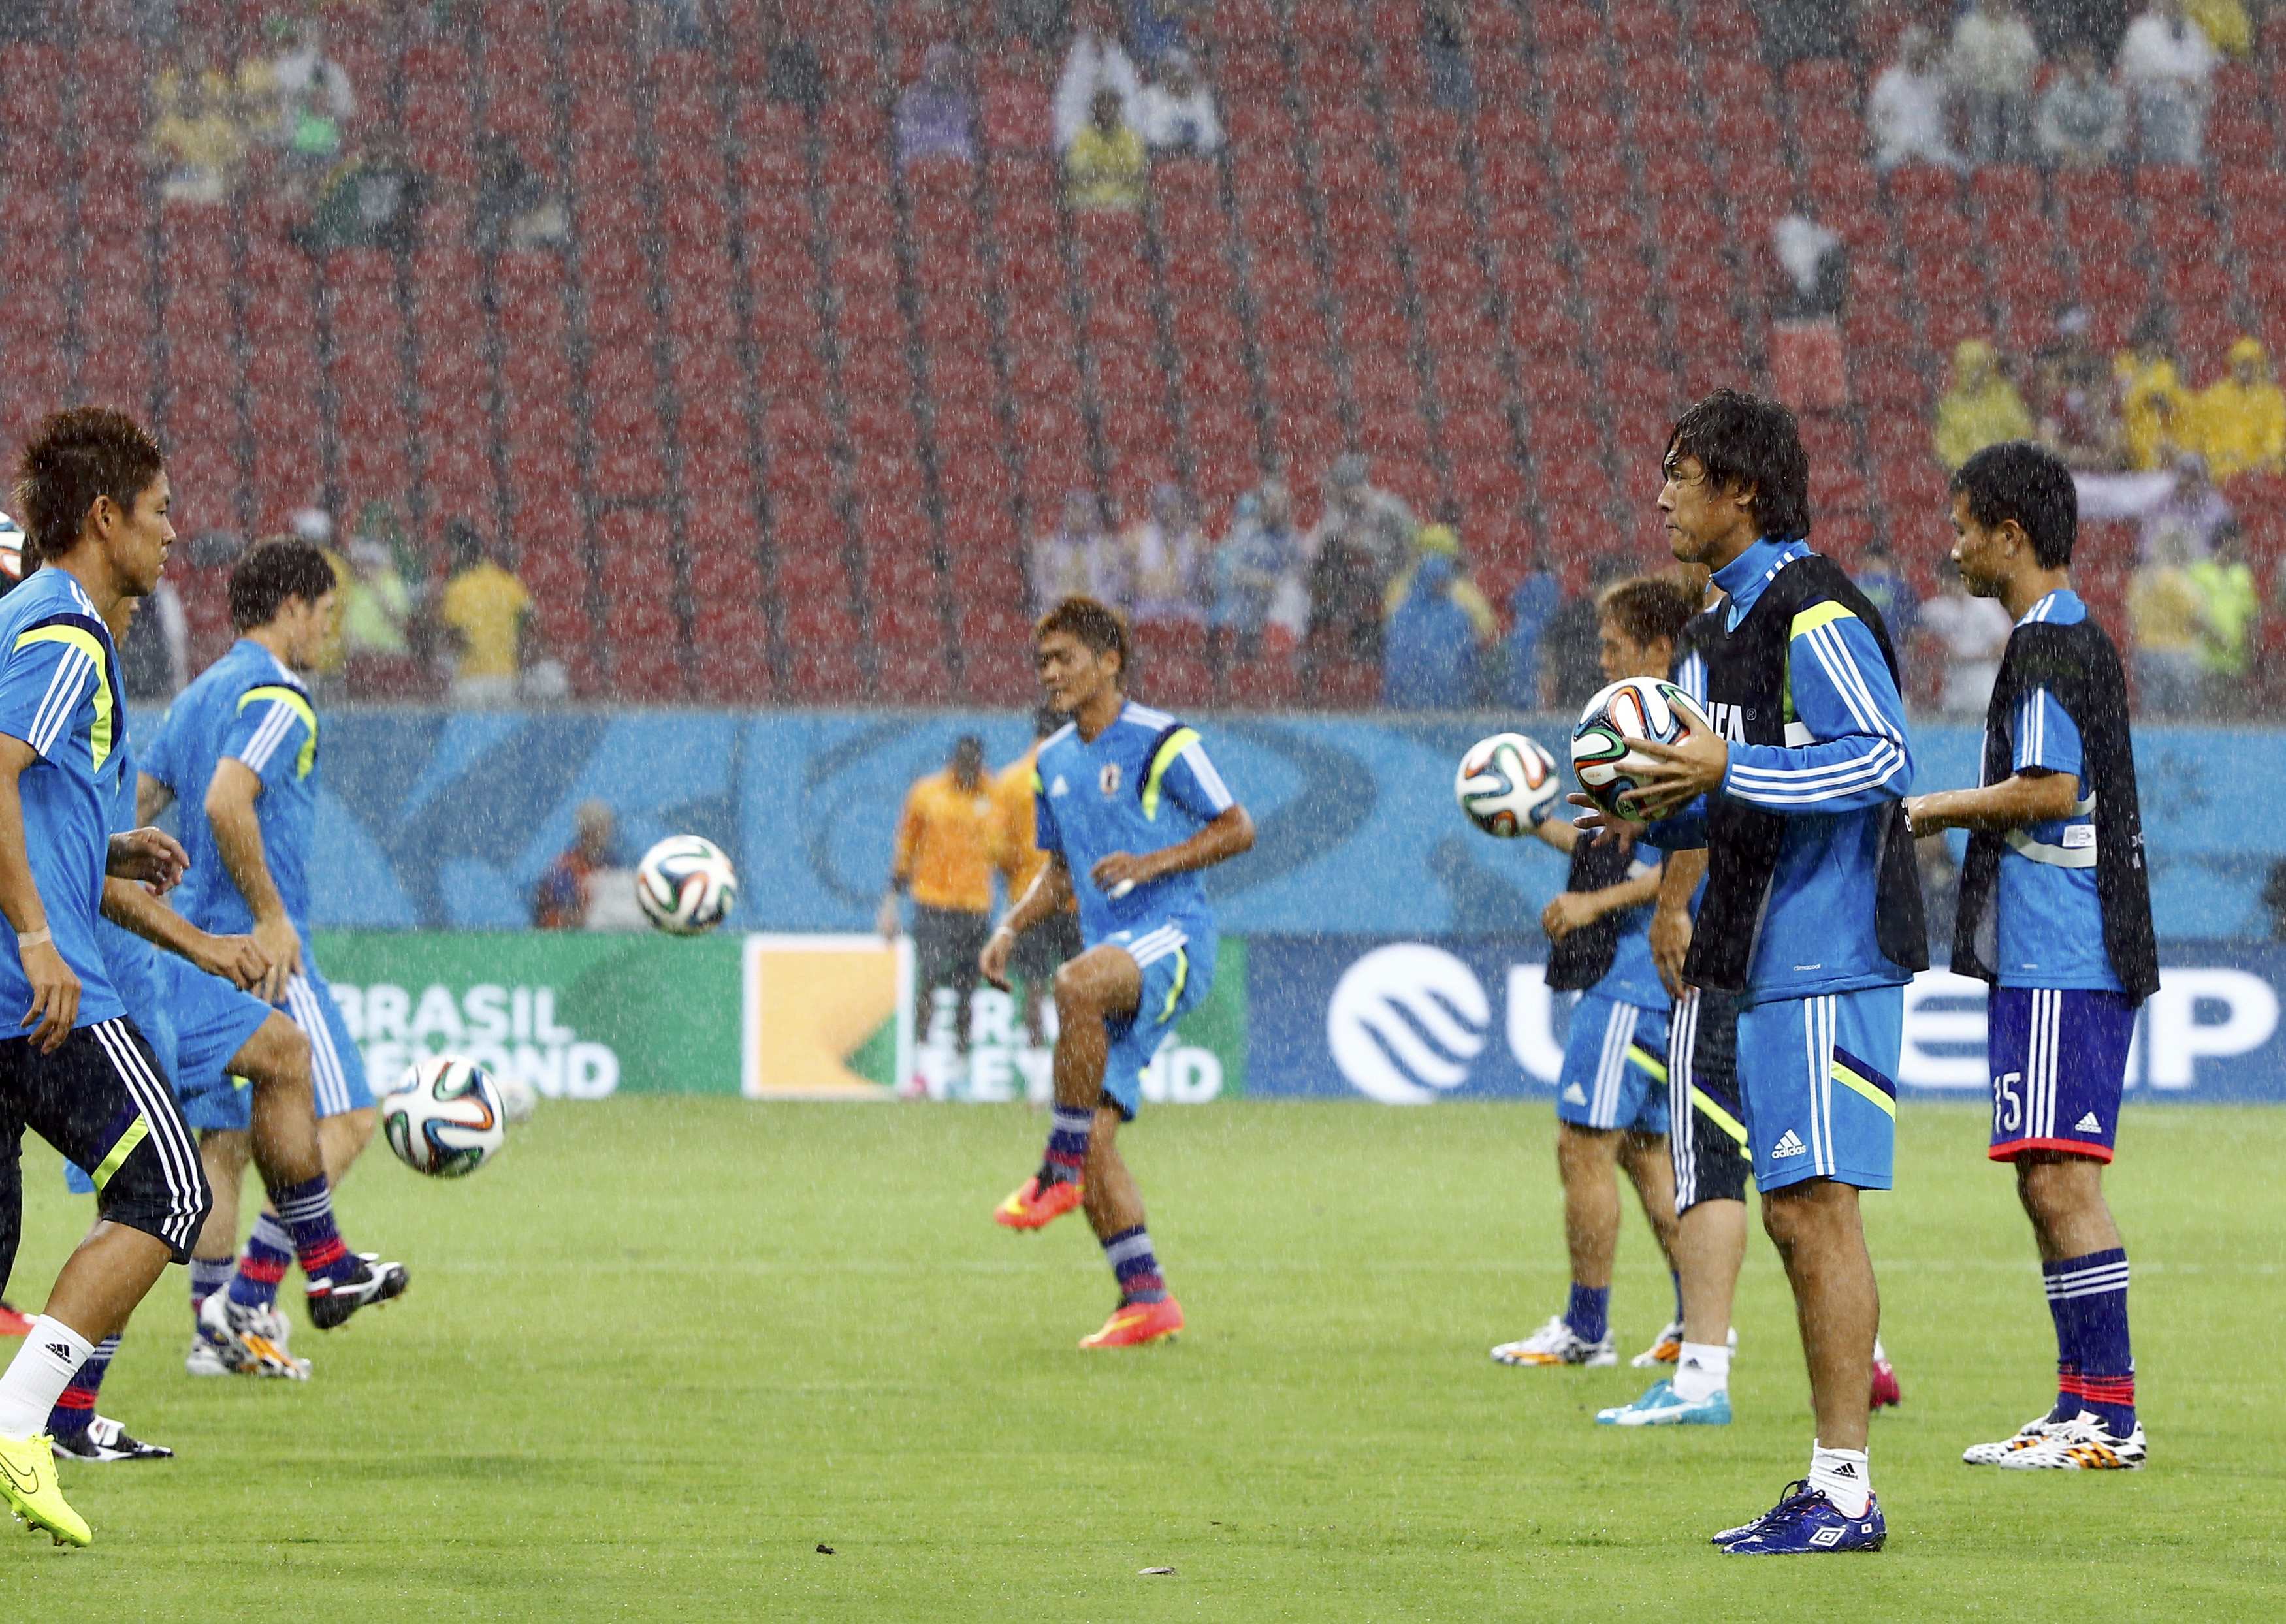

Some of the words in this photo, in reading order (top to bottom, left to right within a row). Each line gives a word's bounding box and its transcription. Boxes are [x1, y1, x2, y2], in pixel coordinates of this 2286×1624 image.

[1705, 701, 1745, 746] IFA
[1993, 1072, 2021, 1134] 15
[1771, 1145, 1807, 1159] adidas
